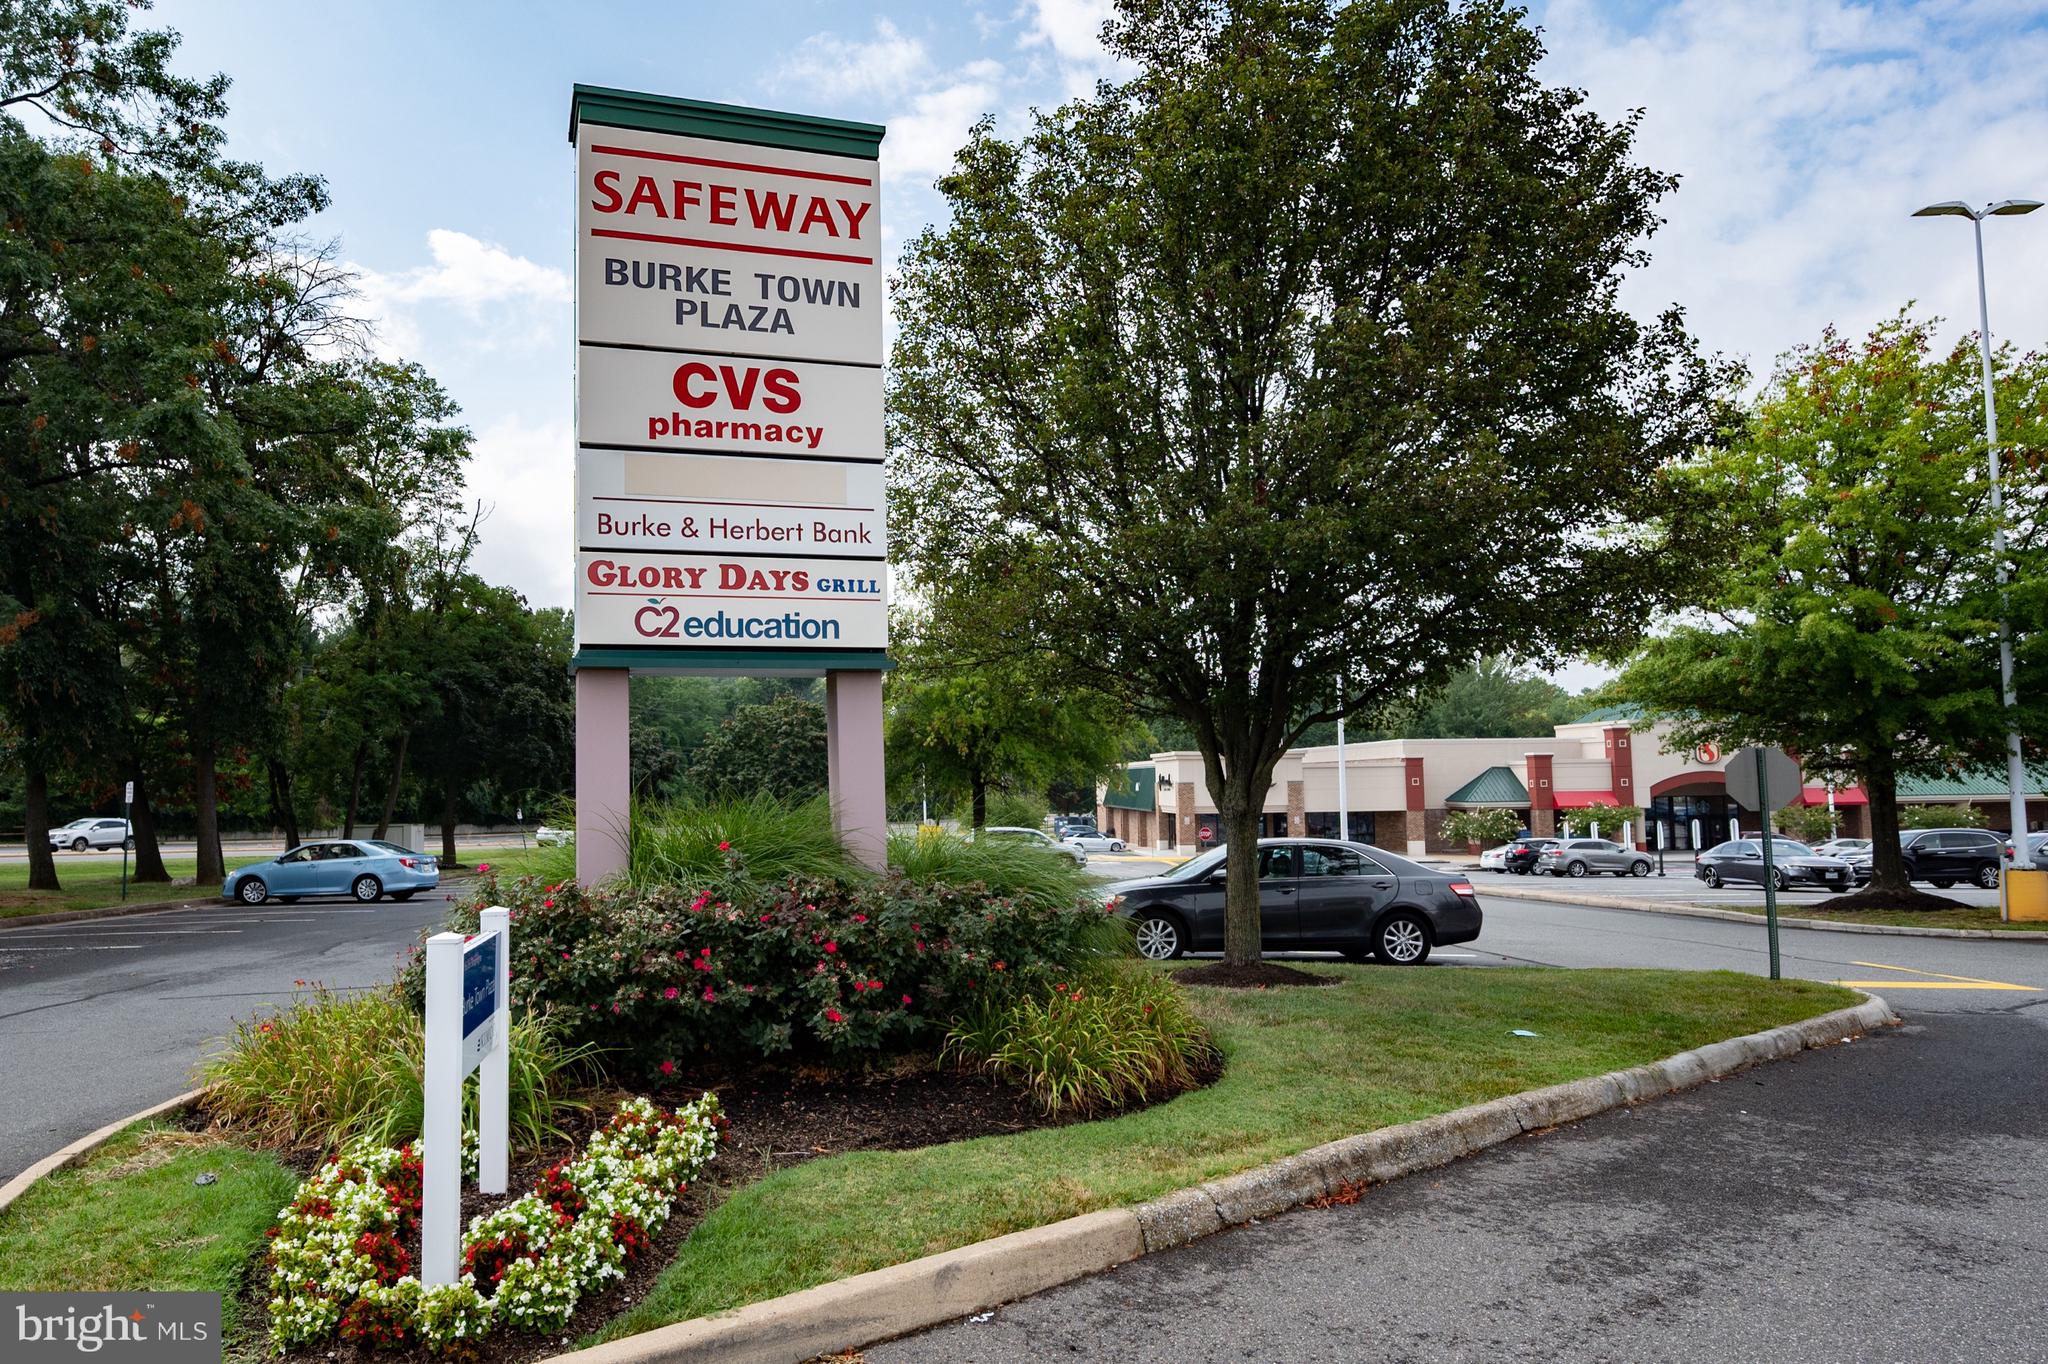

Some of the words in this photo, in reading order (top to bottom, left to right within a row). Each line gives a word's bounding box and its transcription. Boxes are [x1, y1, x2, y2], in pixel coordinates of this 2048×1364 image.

[591, 170, 872, 240] SAFEWAY
[605, 258, 732, 296] BURKE
[754, 273, 860, 309] TOWN
[675, 299, 795, 335] PLAZA
[672, 362, 801, 414] CVS
[648, 412, 823, 449] pharmacy
[598, 513, 671, 537] Burke
[681, 517, 699, 538] &
[710, 517, 803, 542] Herbert
[813, 522, 872, 544] Bank
[587, 560, 707, 589] GLORY
[718, 564, 809, 592] DAYS
[817, 578, 880, 594] GRILL
